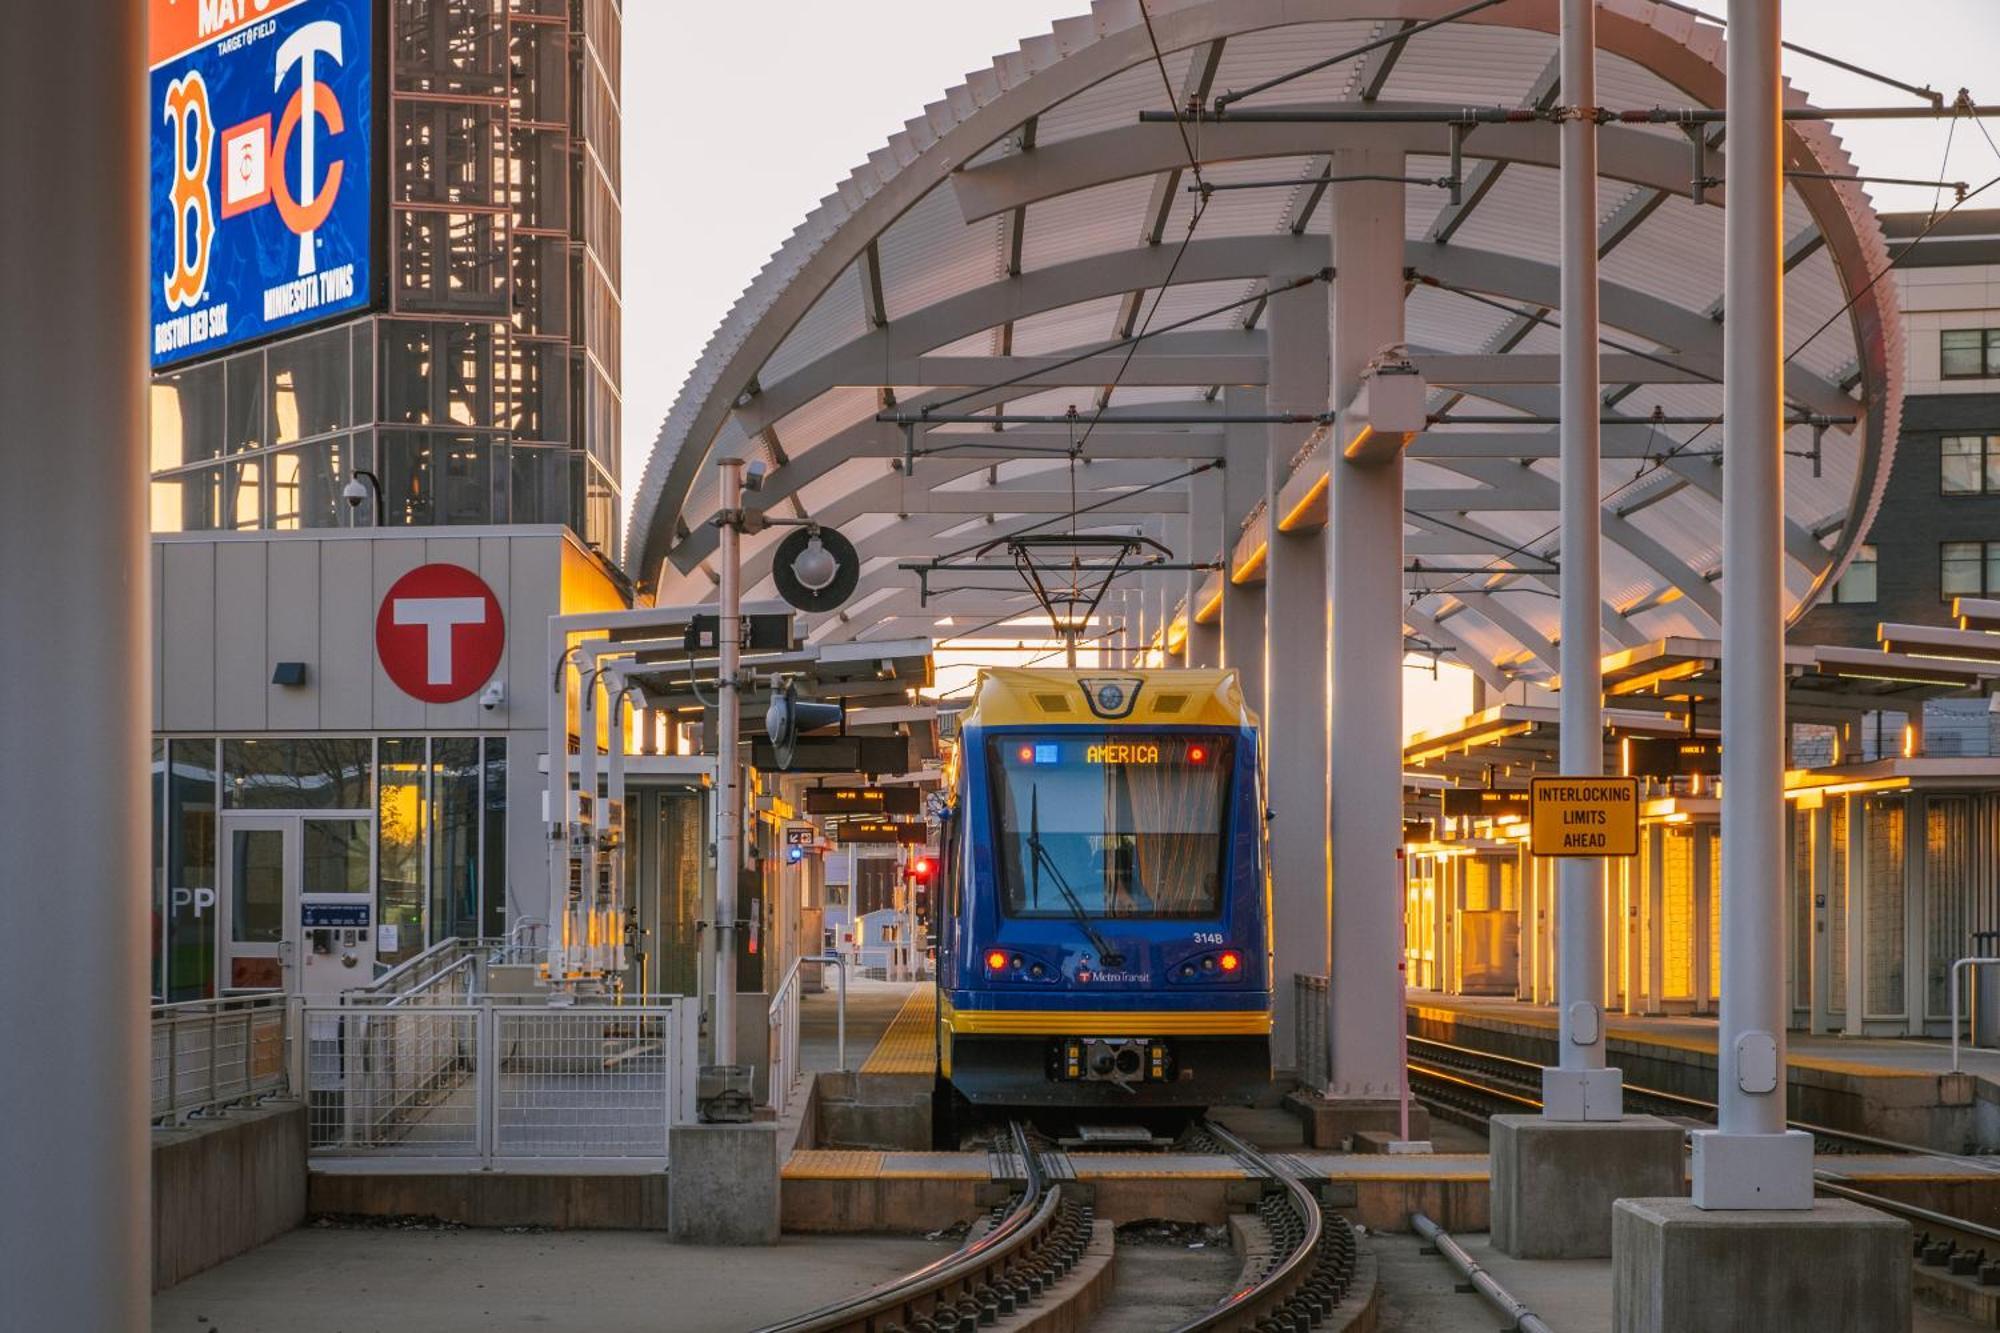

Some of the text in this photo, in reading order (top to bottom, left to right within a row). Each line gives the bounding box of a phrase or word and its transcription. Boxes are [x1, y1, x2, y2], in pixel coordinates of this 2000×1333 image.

[218, 19, 276, 56] TARGET FIELD
[264, 263, 353, 321] MINNESOTA TWINS
[155, 303, 228, 354] BOSTON RED SOX
[393, 597, 486, 684] T
[1087, 745, 1159, 763] AMERICA
[1539, 787, 1631, 802] INTERLOCKING
[1563, 810, 1606, 825] LIMITS
[1563, 833, 1606, 848] AHEAD
